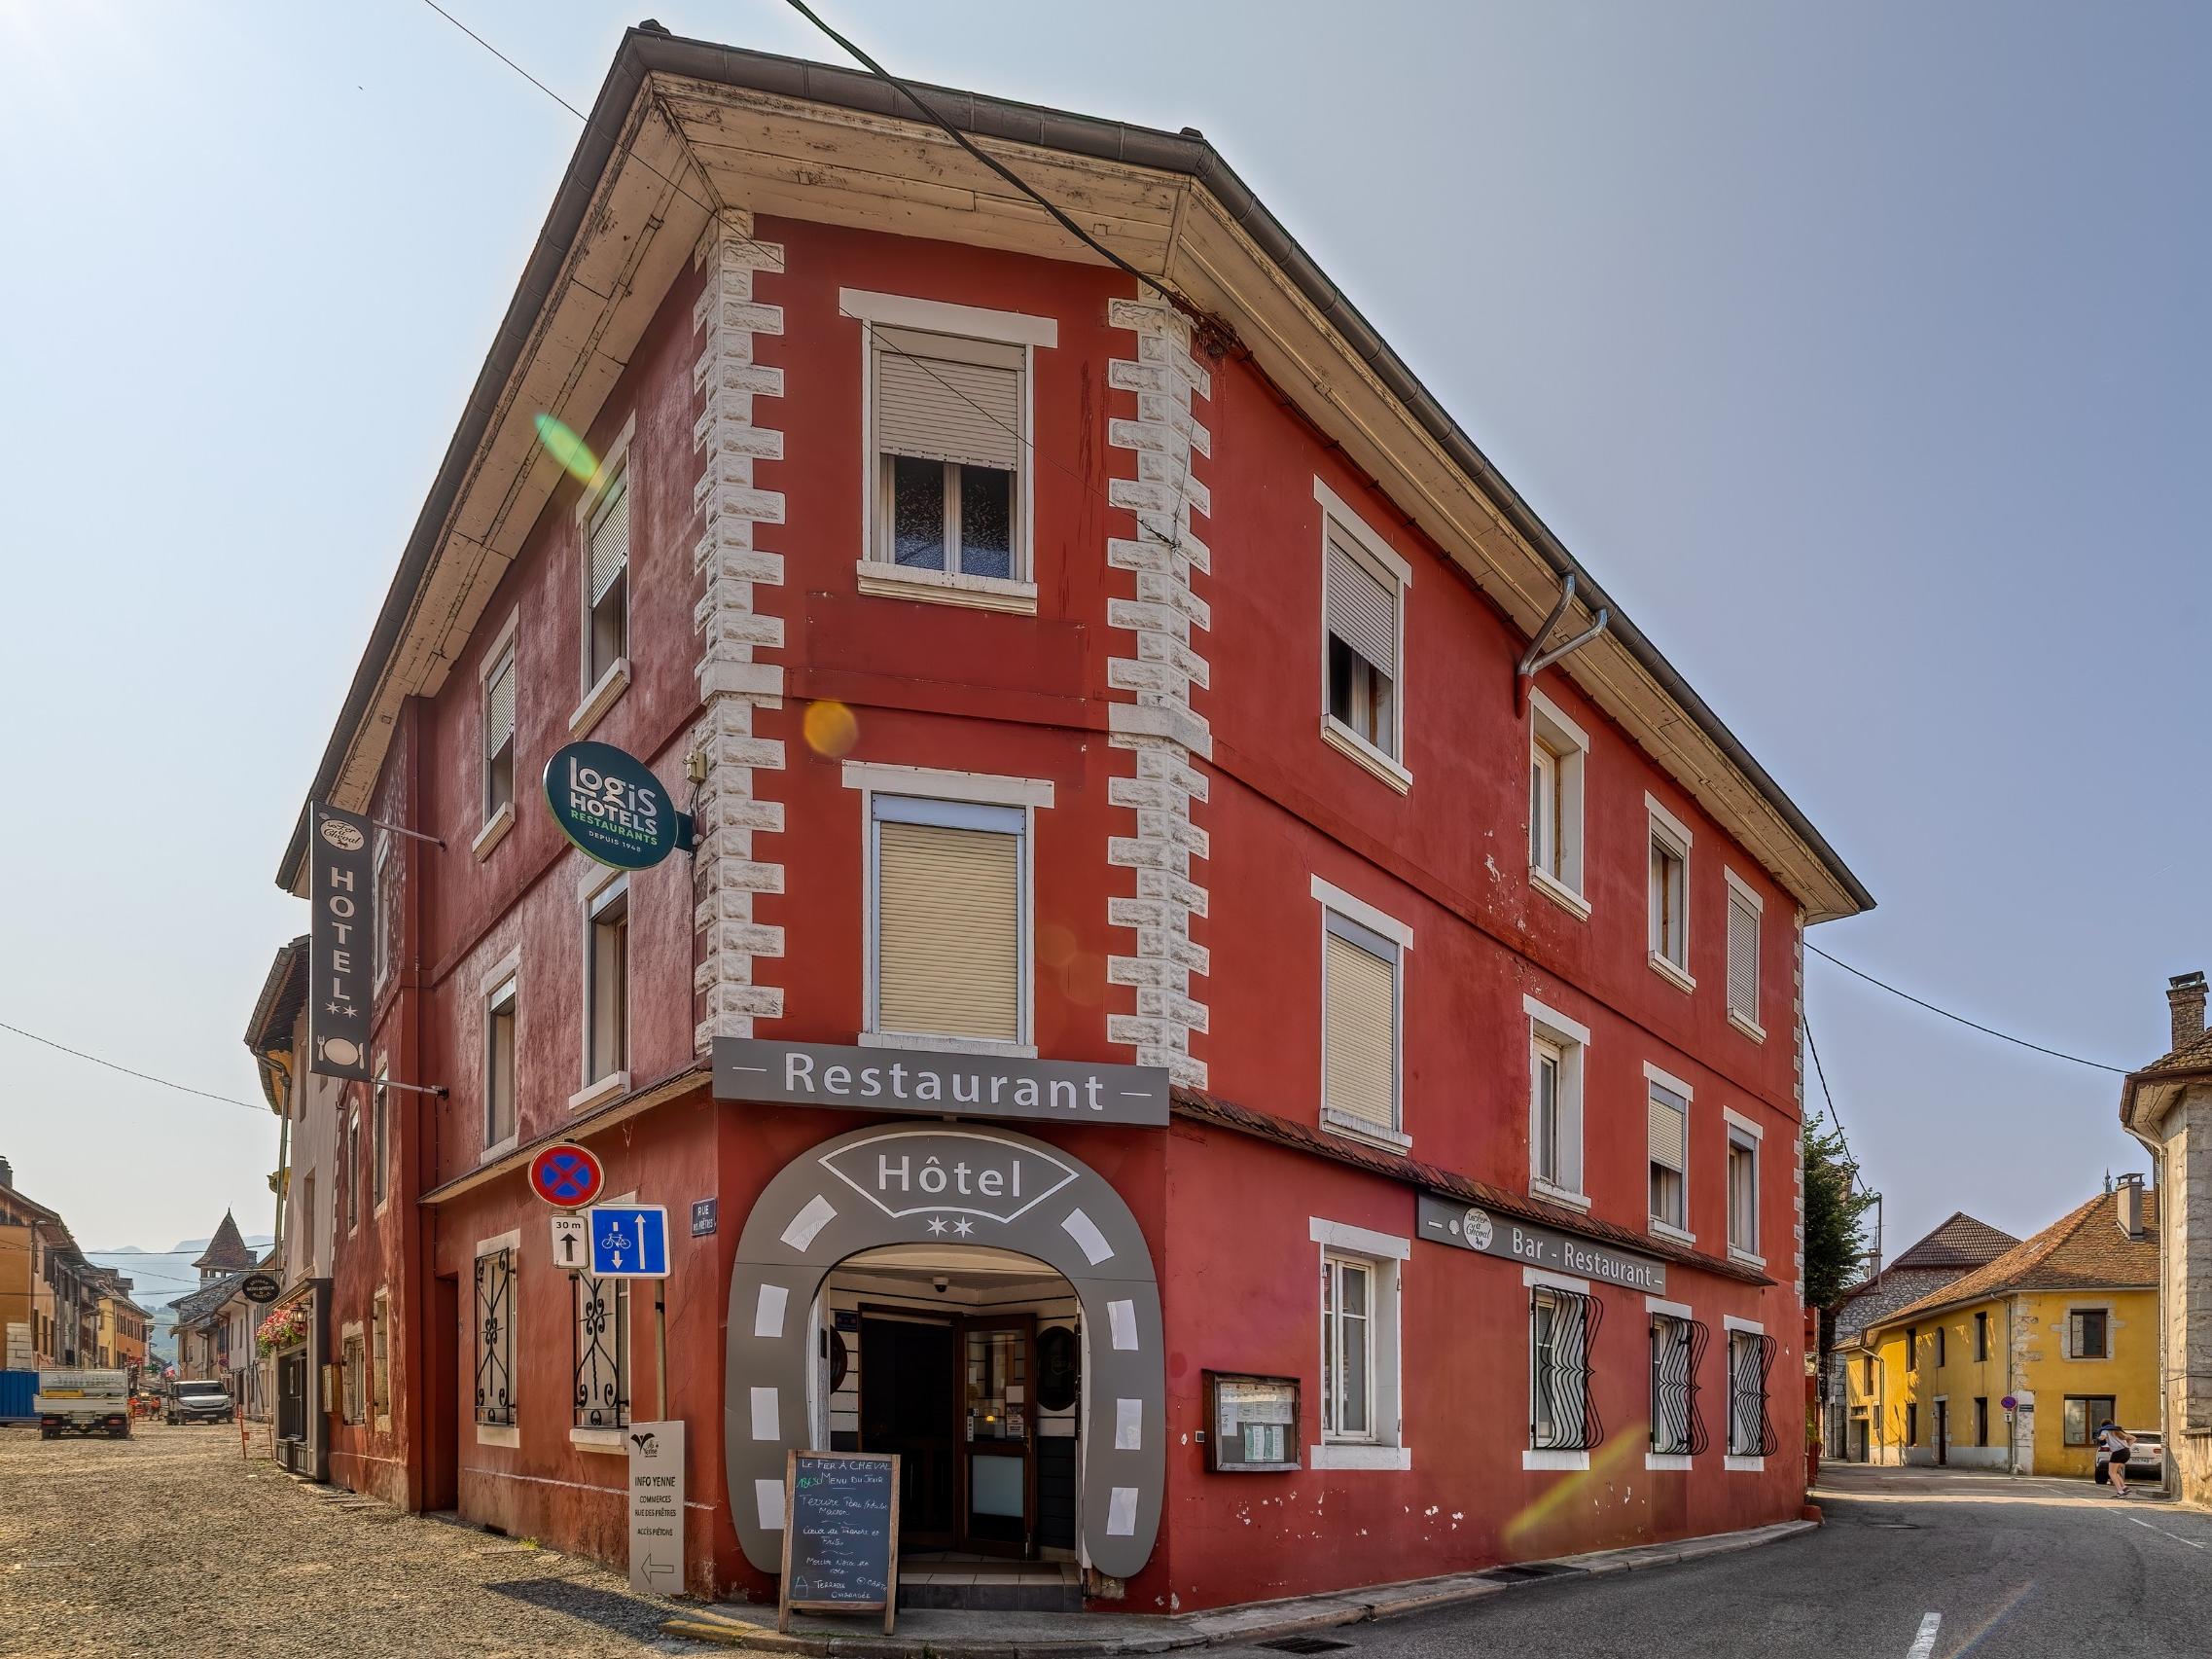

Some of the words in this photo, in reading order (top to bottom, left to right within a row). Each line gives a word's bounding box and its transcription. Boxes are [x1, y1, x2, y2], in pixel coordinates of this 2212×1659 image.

[570, 791, 658, 836] HOTELS
[570, 810, 658, 846] RESTAURANTS
[589, 830, 620, 846] DEPUIS
[623, 842, 642, 852] 1948
[329, 866, 355, 1000] HOTEL
[784, 1052, 1104, 1111] Restaurant
[878, 1154, 1021, 1198] Hôtel
[697, 1205, 709, 1216] RUE
[1512, 1227, 1545, 1260] Bar
[1564, 1242, 1652, 1287] Restaurant
[817, 1459, 837, 1470] FER
[849, 1461, 892, 1471] CHEVAL
[634, 1476, 652, 1487] INFO
[652, 1476, 676, 1487] YENNE
[821, 1472, 848, 1485] MENU
[639, 1495, 672, 1503] COMMERCES
[634, 1508, 645, 1517] RUE
[655, 1507, 677, 1517] PRÊTRES
[637, 1526, 652, 1535] ACCÈS
[653, 1527, 673, 1536] PIÉTONS
